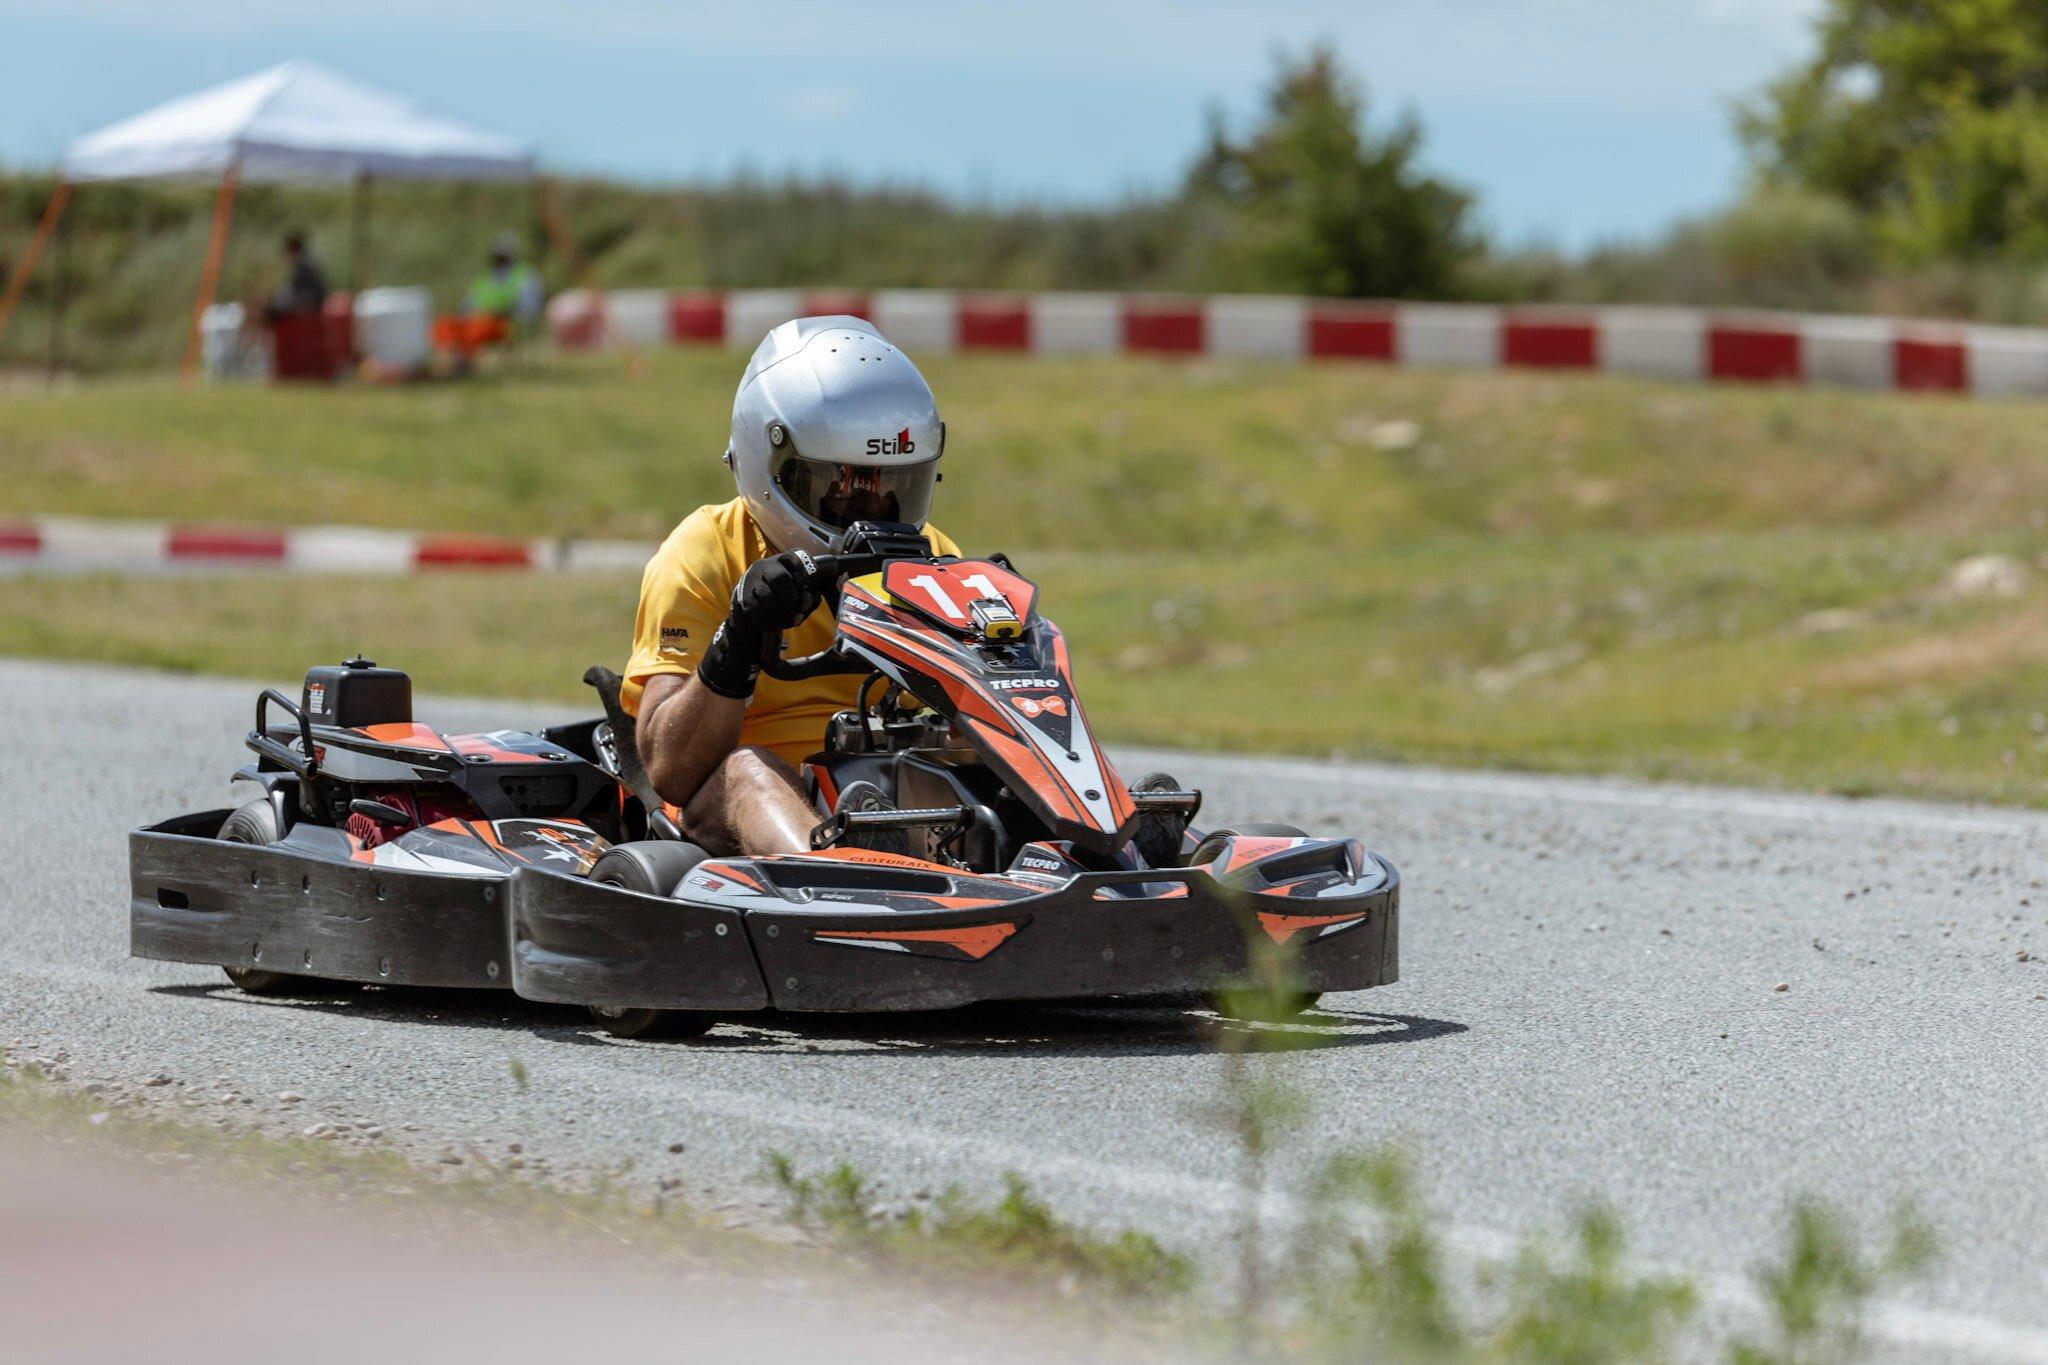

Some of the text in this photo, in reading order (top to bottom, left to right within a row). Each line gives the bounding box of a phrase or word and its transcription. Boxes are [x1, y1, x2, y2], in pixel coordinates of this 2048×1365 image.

[866, 427, 915, 455] Stilo
[661, 627, 689, 638] HAFA
[990, 679, 1060, 690] TECPRO
